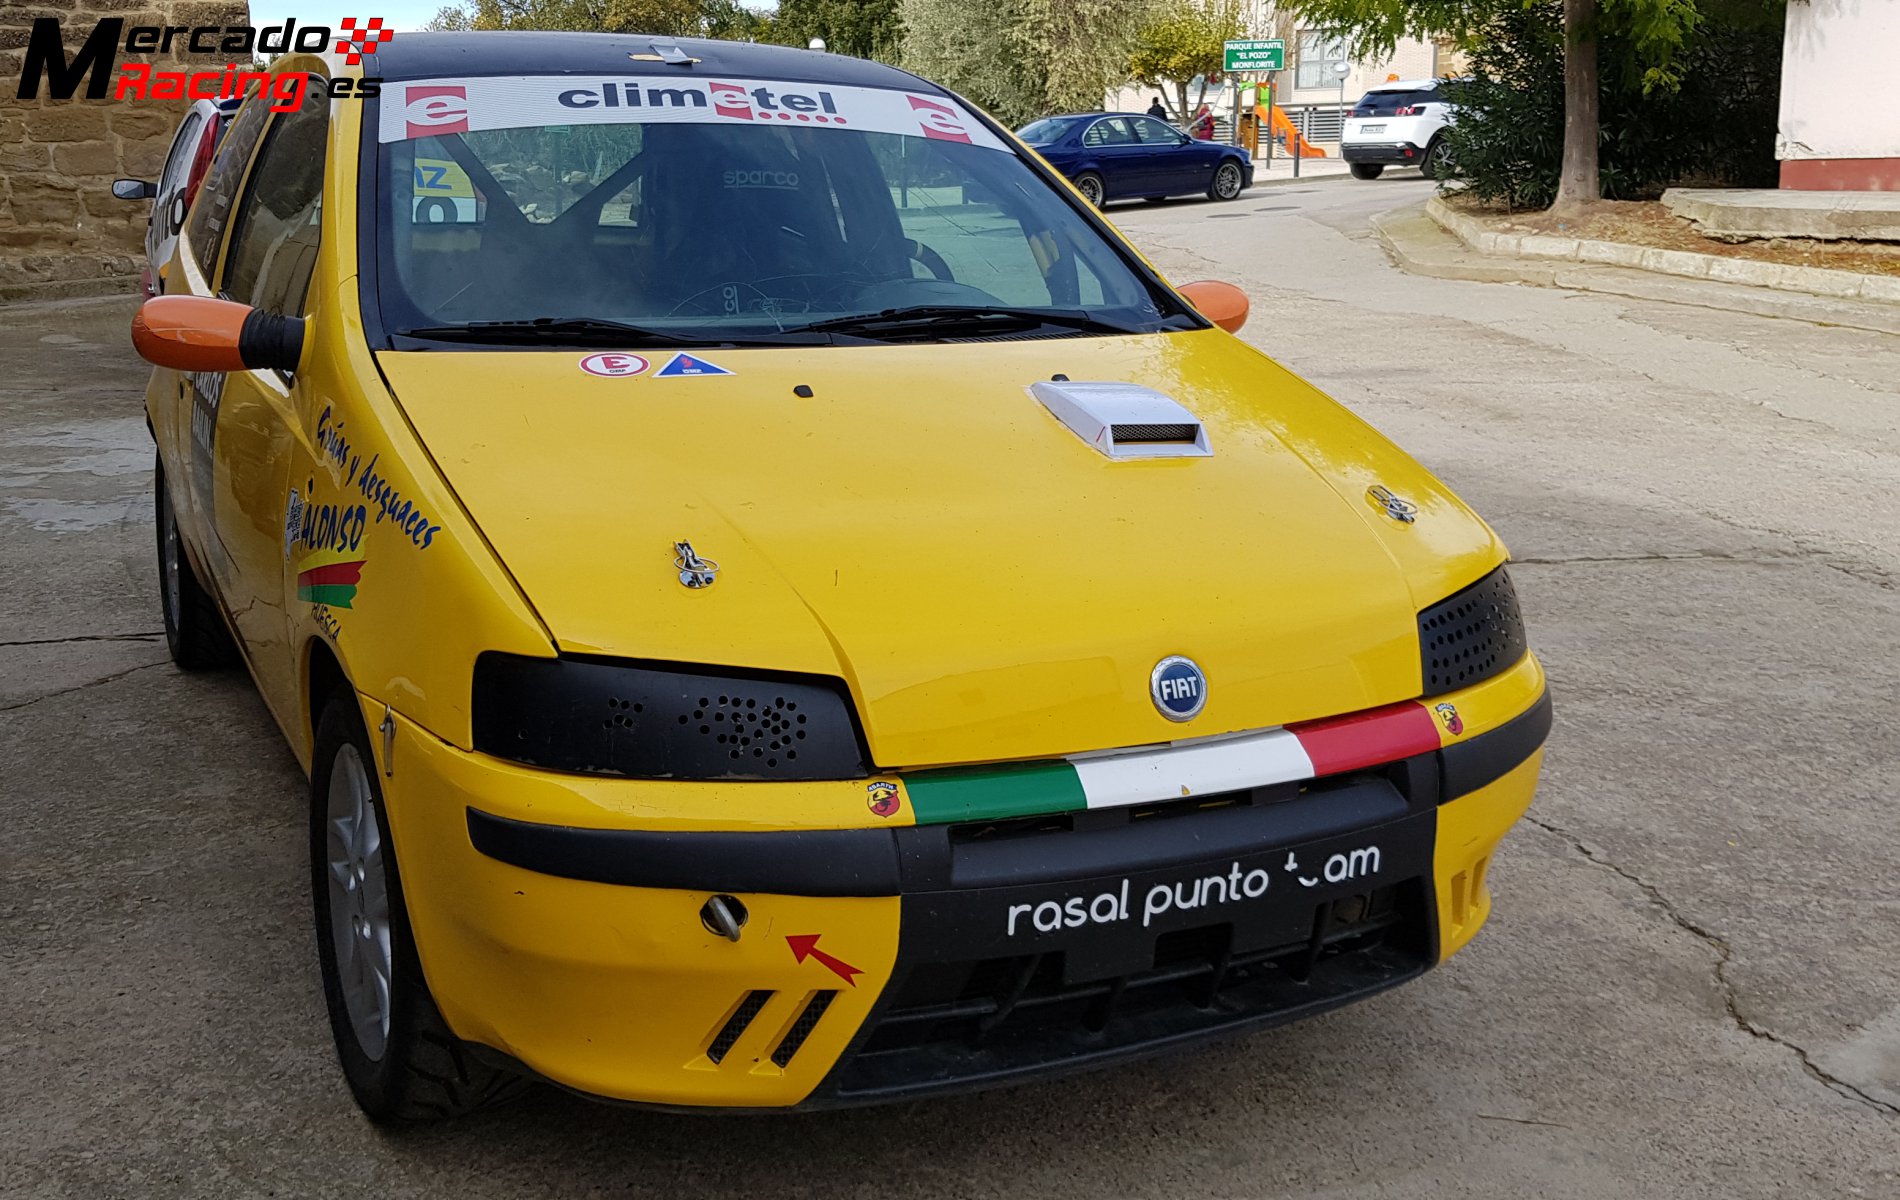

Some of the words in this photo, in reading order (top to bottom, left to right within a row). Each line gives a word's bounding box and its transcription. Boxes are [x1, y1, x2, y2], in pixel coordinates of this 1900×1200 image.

[1226, 42, 1252, 50] PARQUE
[1253, 41, 1282, 50] INFANTIL
[1231, 61, 1276, 69] MONFLORITE
[557, 82, 838, 116] climetel
[723, 170, 799, 188] sparco
[601, 356, 631, 369] E
[345, 455, 361, 488] y
[358, 453, 441, 550] desguaces
[300, 504, 367, 553] ALONSO
[1160, 676, 1197, 701] FIAT
[868, 782, 896, 791] ABARTH
[1007, 879, 1130, 936] rasal
[1142, 862, 1269, 927] punto
